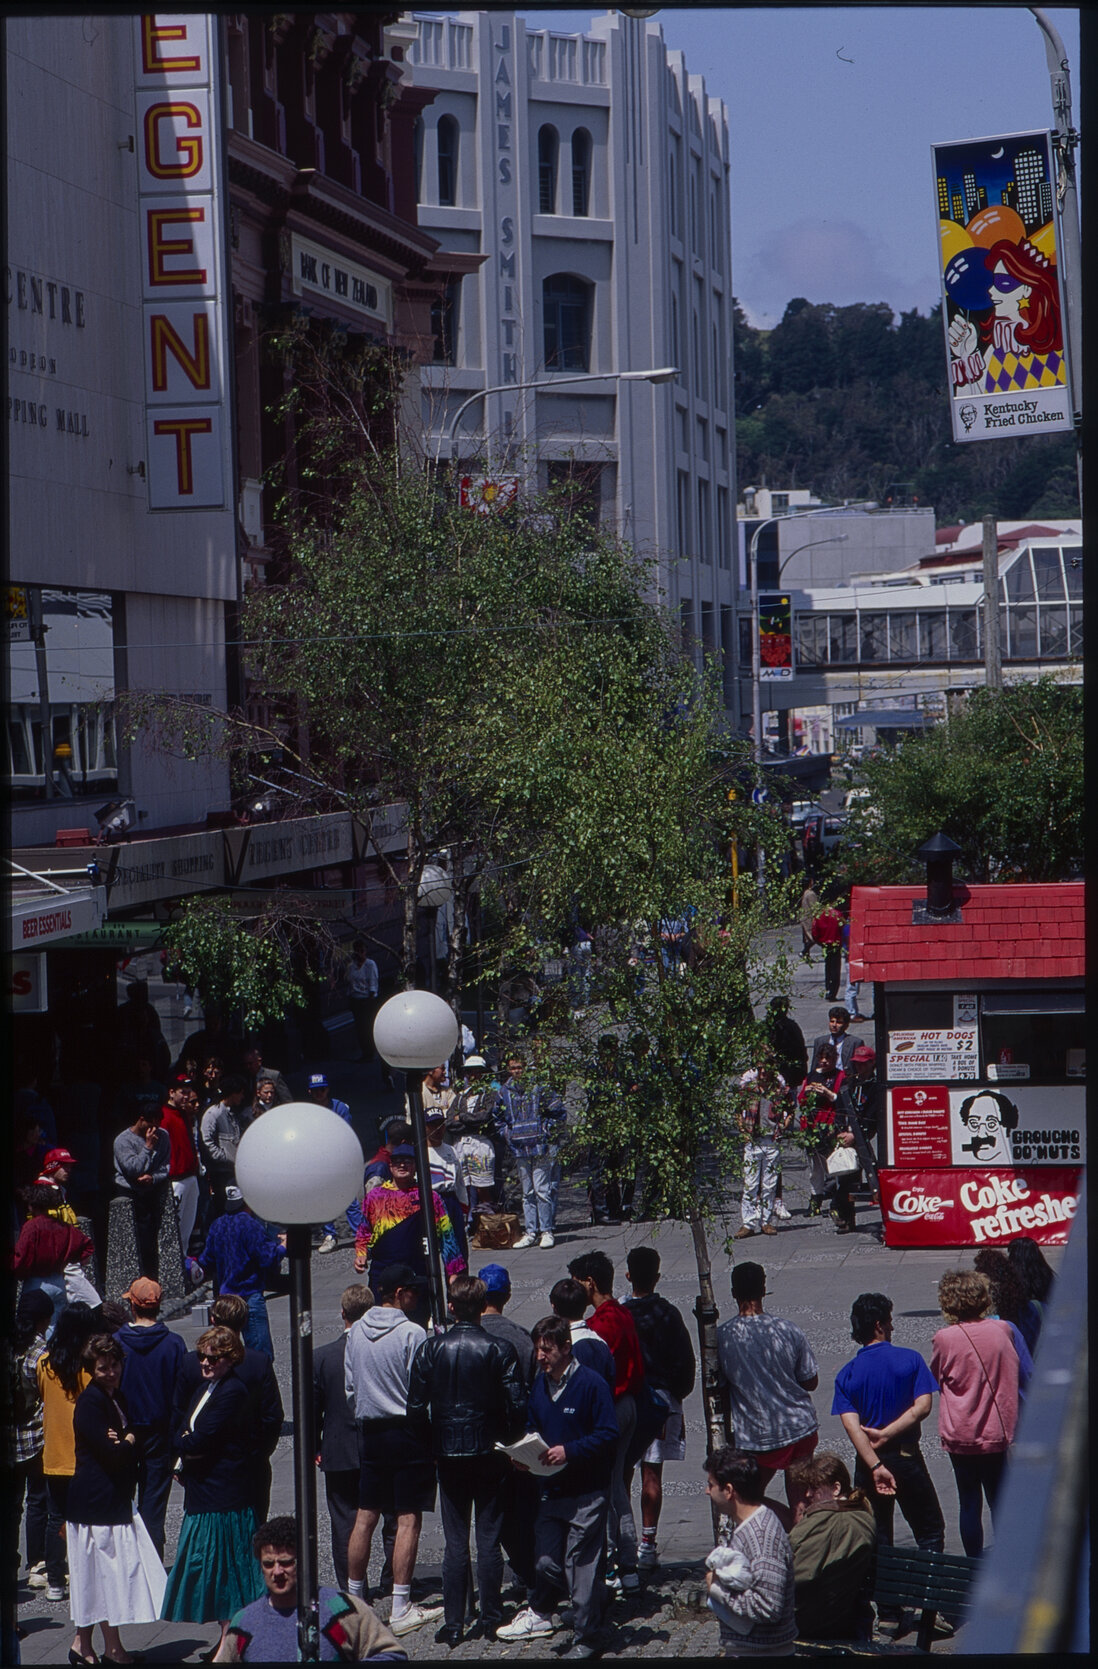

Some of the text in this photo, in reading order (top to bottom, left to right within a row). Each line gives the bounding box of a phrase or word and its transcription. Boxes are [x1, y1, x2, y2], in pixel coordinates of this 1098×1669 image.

[494, 25, 512, 184] JAMES
[301, 251, 318, 285] BANK
[322, 262, 330, 290] OF
[335, 268, 348, 297] NEW
[500, 216, 517, 383] SMITH
[56, 408, 89, 437] MALL
[984, 400, 1038, 418] Kentucky
[984, 410, 1064, 428] Fried Chicken
[23, 910, 71, 939] BEER ESSENTIALS
[920, 1032, 942, 1040] HOT
[946, 1031, 976, 1040] DOGS
[957, 1040, 973, 1051] $2
[1012, 1130, 1080, 1144] GROUCHO
[893, 1190, 943, 1213] Coke
[960, 1176, 1030, 1213] Coke
[970, 1194, 1080, 1242] refreshe
